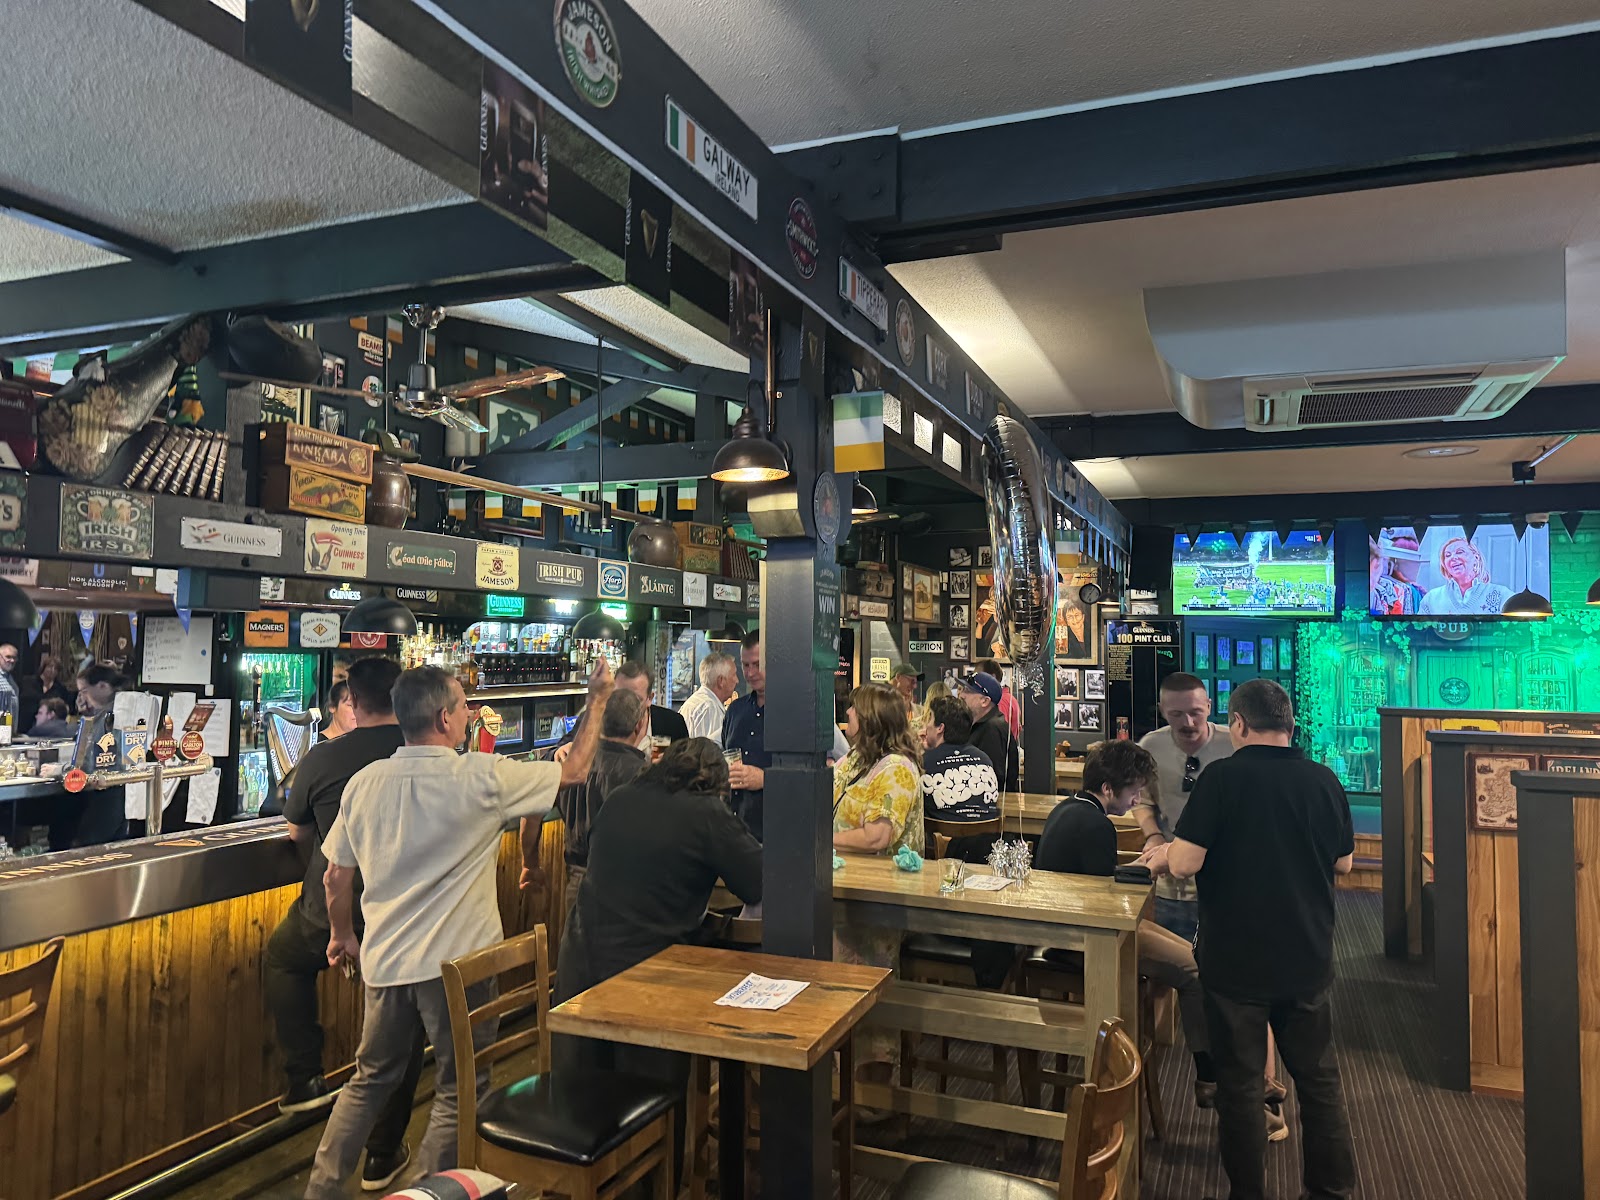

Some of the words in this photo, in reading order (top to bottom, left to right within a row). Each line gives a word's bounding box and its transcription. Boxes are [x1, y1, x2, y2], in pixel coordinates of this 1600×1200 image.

[567, 1, 612, 53] JAMESON
[480, 92, 488, 151] GUINNESS
[703, 136, 750, 197] GALWAY
[715, 170, 740, 203] IRELAND
[293, 442, 347, 464] KINKARA
[84, 522, 133, 541] IRISH
[330, 523, 353, 536] Opening
[353, 526, 366, 536] Time
[223, 534, 266, 547] GUINNESS
[333, 548, 364, 560] GUINNESS
[341, 562, 356, 571] TIME
[539, 564, 564, 578] IRISH
[566, 567, 583, 582] PUB
[603, 573, 622, 585] Harp
[89, 577, 126, 586] ALCOHOLIC
[480, 575, 514, 586] JAMESON
[329, 588, 361, 601] GUINNESS
[397, 588, 426, 599] GUINNESS
[489, 595, 523, 608] GUINNESS
[818, 594, 836, 614] WIN
[250, 622, 284, 632] MAGNERS
[1438, 622, 1469, 633] PUB
[1116, 633, 1133, 644] 100
[1134, 635, 1152, 643] PINT
[1152, 635, 1172, 643] CLUB
[909, 642, 942, 651] CEPTION
[125, 737, 147, 745] DRY
[96, 755, 116, 764] DRY
